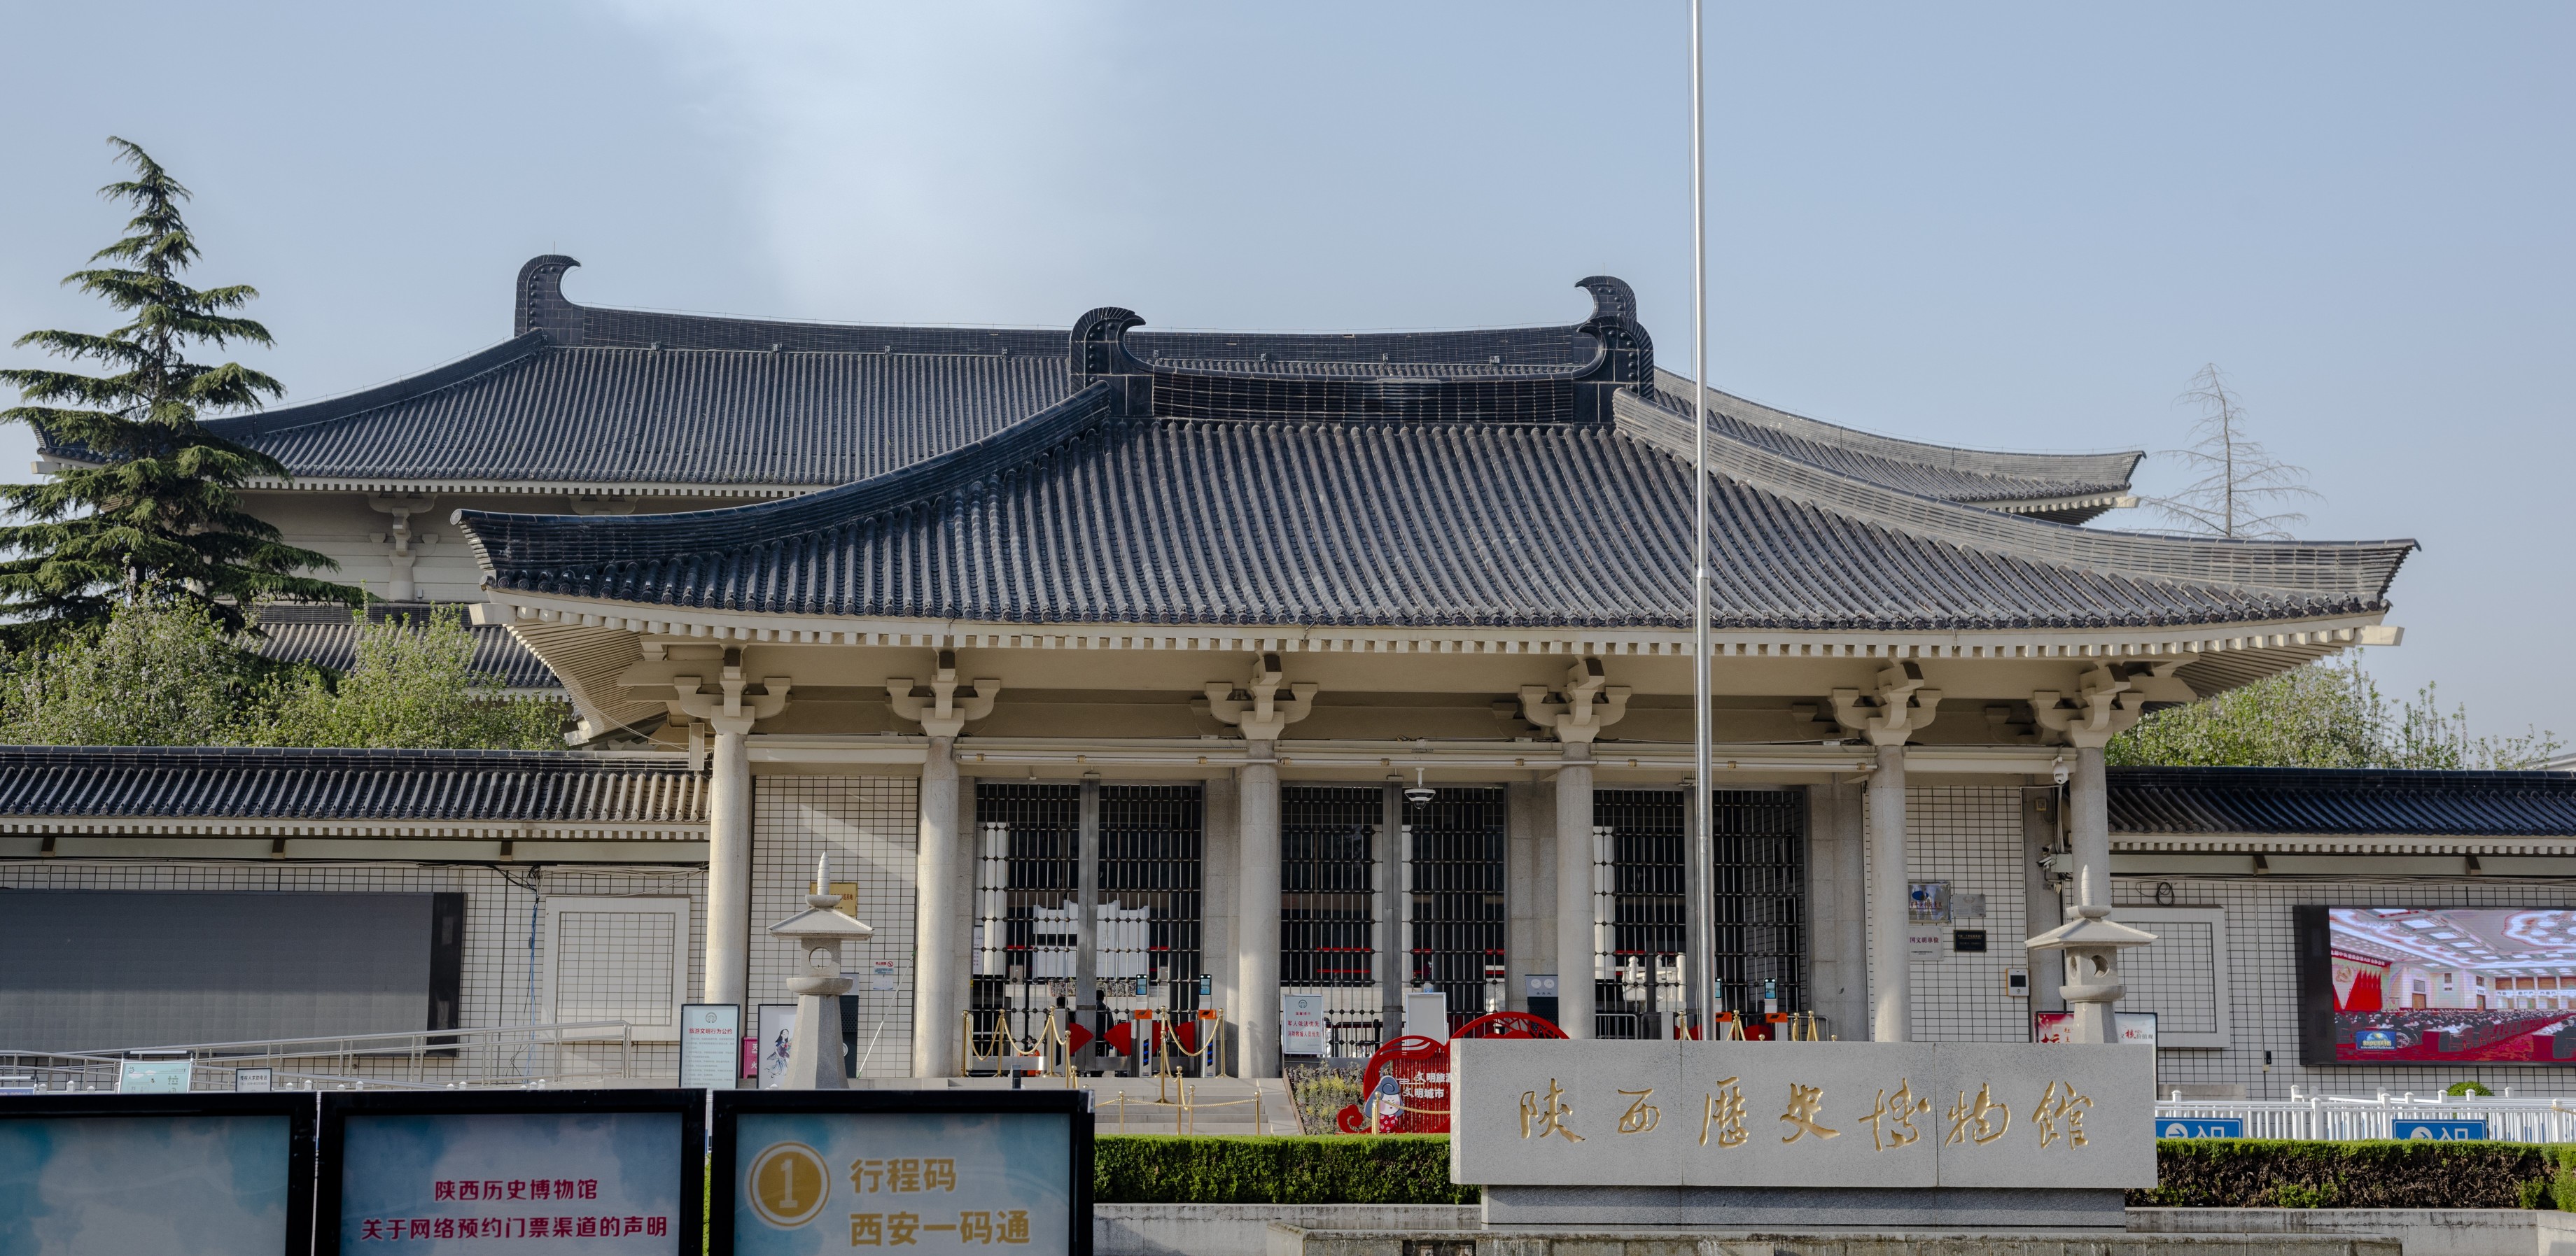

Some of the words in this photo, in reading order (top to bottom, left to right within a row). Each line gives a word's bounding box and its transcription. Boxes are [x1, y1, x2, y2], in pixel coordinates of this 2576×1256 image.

[1402, 1087, 1444, 1099] 文明城市
[2196, 1125, 2225, 1138] 入口
[2439, 1127, 2468, 1141] 入口
[849, 1157, 958, 1194] 行程码
[434, 1179, 599, 1201] 陕西历史博物馆
[360, 1215, 668, 1241] 关于网络预约门票渠道的声明
[850, 1210, 1031, 1247] 西安一码通
